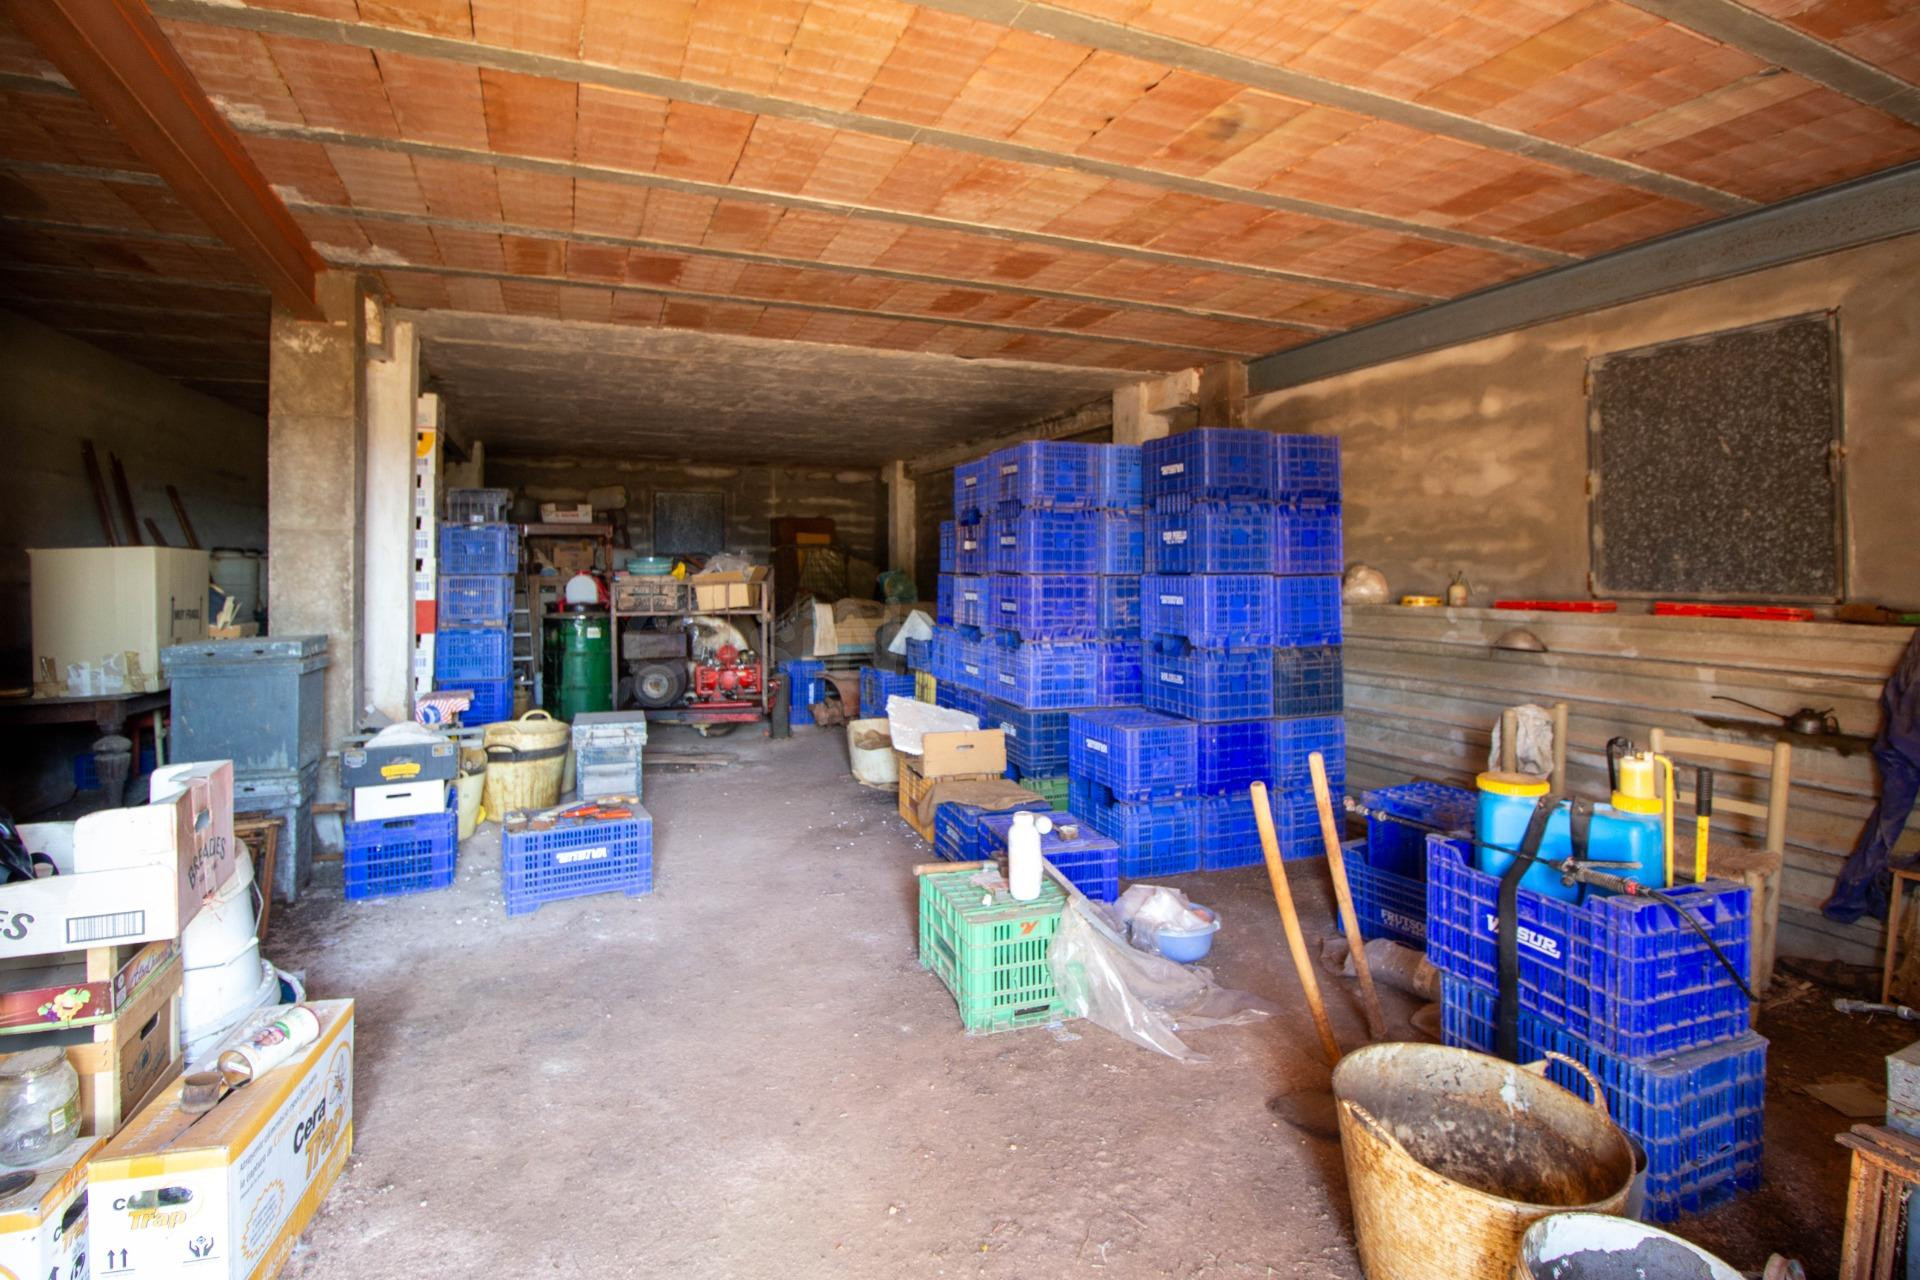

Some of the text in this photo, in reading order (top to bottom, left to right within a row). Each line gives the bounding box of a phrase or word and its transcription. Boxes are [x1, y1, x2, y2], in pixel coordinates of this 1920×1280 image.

[1486, 914, 1561, 959] VSUR
[293, 1097, 326, 1154] Cera
[128, 1208, 187, 1231] Trap
